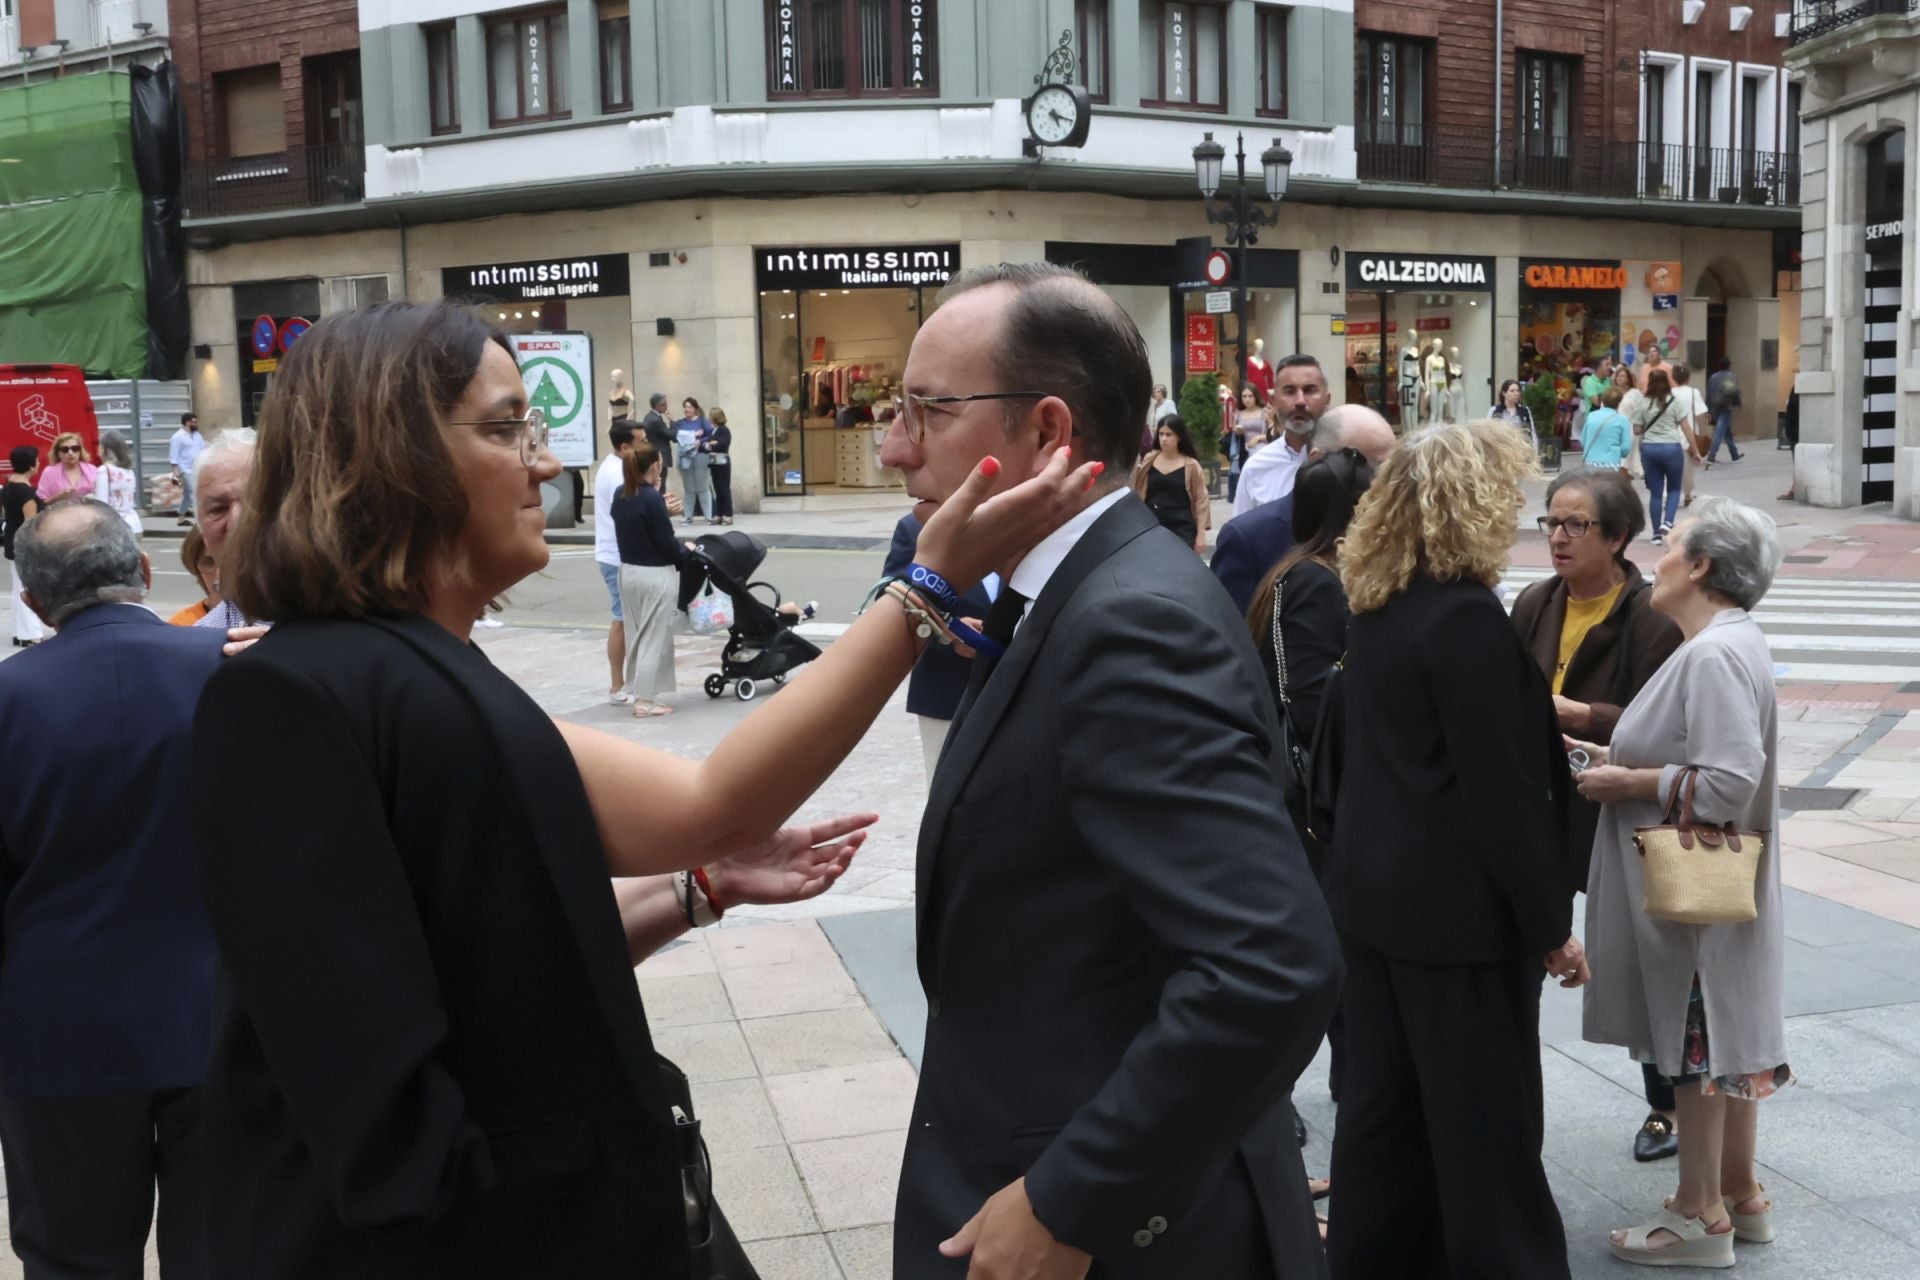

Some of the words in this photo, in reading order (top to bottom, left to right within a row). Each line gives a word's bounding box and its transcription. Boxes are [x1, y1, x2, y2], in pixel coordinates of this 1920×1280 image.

[911, 0, 923, 80] OTARIA
[1173, 12, 1183, 96] NOTARIA
[529, 25, 540, 108] NOTARIA
[1533, 61, 1541, 129] OTARIA
[1866, 220, 1903, 240] SEPHO
[767, 250, 950, 271] intimissimi
[1360, 259, 1486, 283] CALZEDONIA
[470, 261, 598, 287] intimissimi
[841, 271, 889, 284] Italian
[892, 268, 950, 285] lingerie
[1525, 264, 1628, 289] CARAMELO
[522, 285, 555, 297] Italian
[557, 282, 599, 297] lingerie
[526, 342, 561, 351] SPAR
